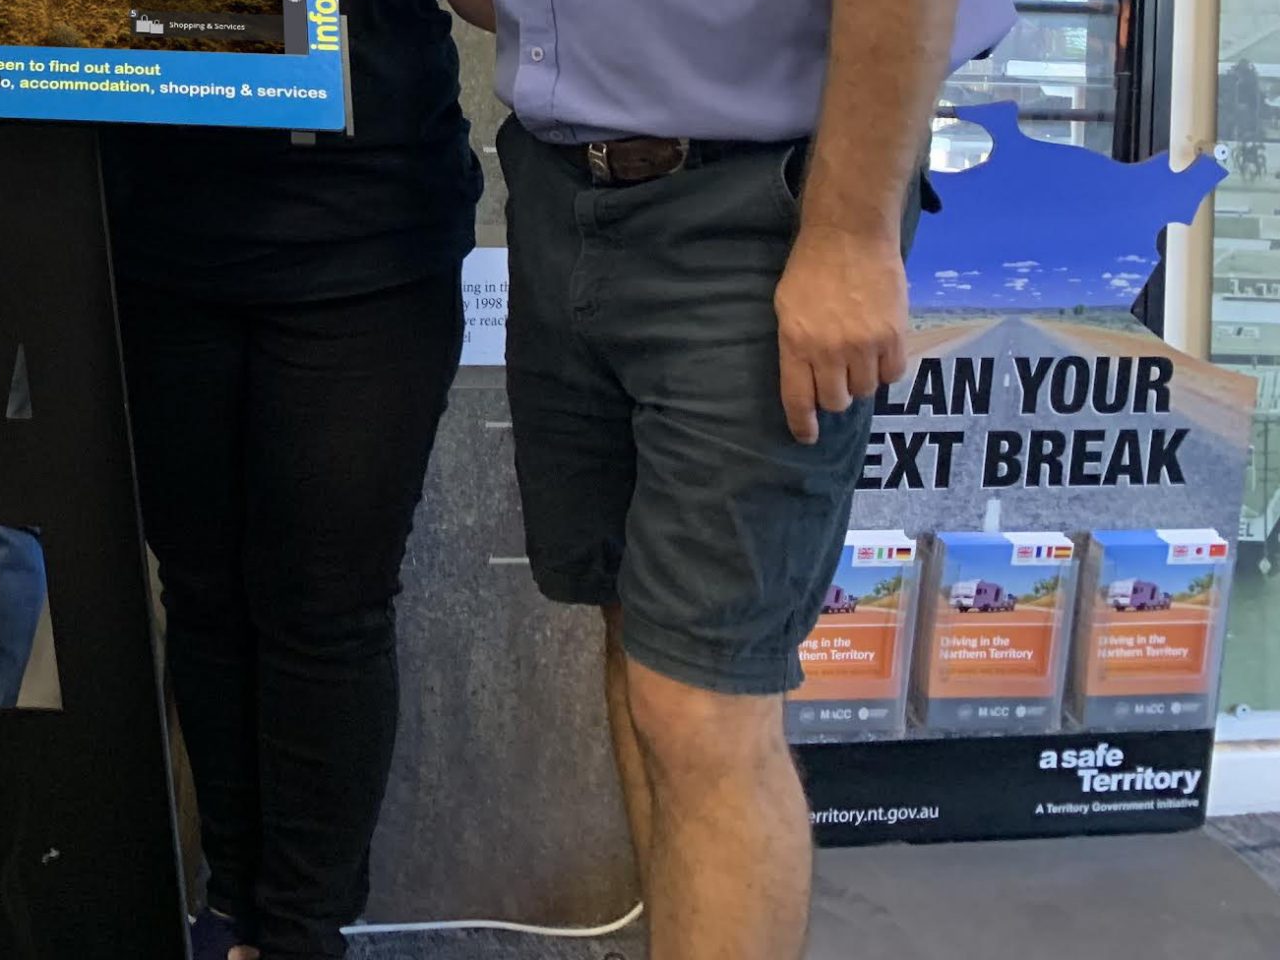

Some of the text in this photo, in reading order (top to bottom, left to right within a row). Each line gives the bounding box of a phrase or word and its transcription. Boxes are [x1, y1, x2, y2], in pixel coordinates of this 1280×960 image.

[169, 22, 205, 31] Shopping
[29, 61, 45, 72] to
[49, 60, 79, 73] find
[84, 63, 111, 74] out
[114, 63, 161, 76] about
[19, 79, 155, 95] accommodation,
[159, 82, 236, 98] shopping
[240, 83, 253, 96] &
[257, 85, 327, 99] services
[463, 282, 481, 294] ing
[485, 282, 496, 292] in
[475, 298, 502, 309] 1998
[464, 317, 476, 326] ve
[874, 356, 1174, 416] LAN YOUR
[856, 428, 1191, 490] EXT BREAK
[821, 638, 831, 647] in
[833, 637, 851, 647] the
[981, 637, 990, 646] in
[992, 636, 1010, 646] the
[1137, 635, 1146, 644] in
[1148, 634, 1166, 644] the
[799, 649, 875, 662] thern Territory
[990, 648, 1034, 660] Territory
[1146, 646, 1189, 657] Territory
[1039, 743, 1124, 768] a safe
[1078, 767, 1202, 794] Territory
[1035, 805, 1045, 815] A
[1046, 803, 1090, 814] Territory
[1092, 801, 1155, 812] Government
[808, 805, 940, 824] erritory.nt.gov.au
